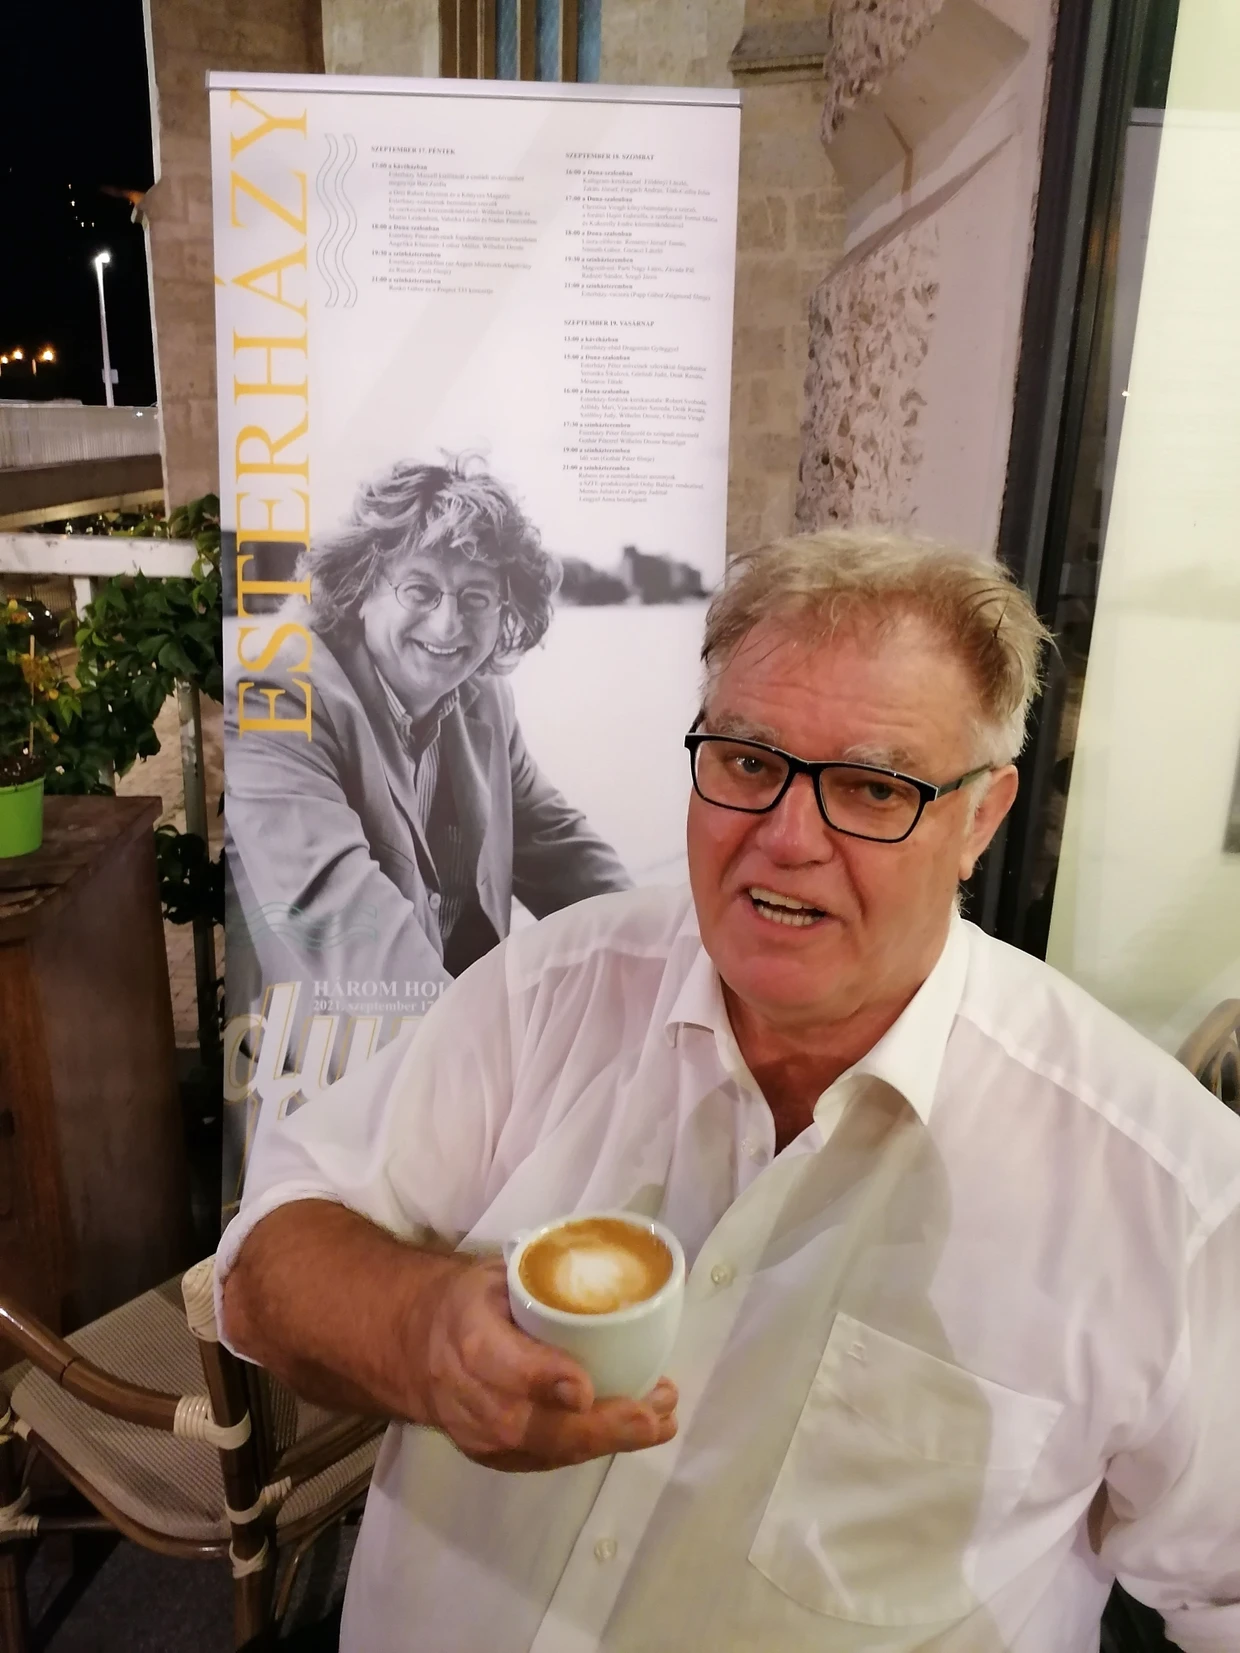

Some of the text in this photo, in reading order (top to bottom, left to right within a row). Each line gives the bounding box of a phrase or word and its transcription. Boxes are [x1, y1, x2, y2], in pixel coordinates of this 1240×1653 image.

[214, 89, 313, 743] ESTERHÁZY
[313, 976, 398, 997] HÁROM
[313, 999, 345, 1012] 2021.
[348, 999, 417, 1013] szeptember
